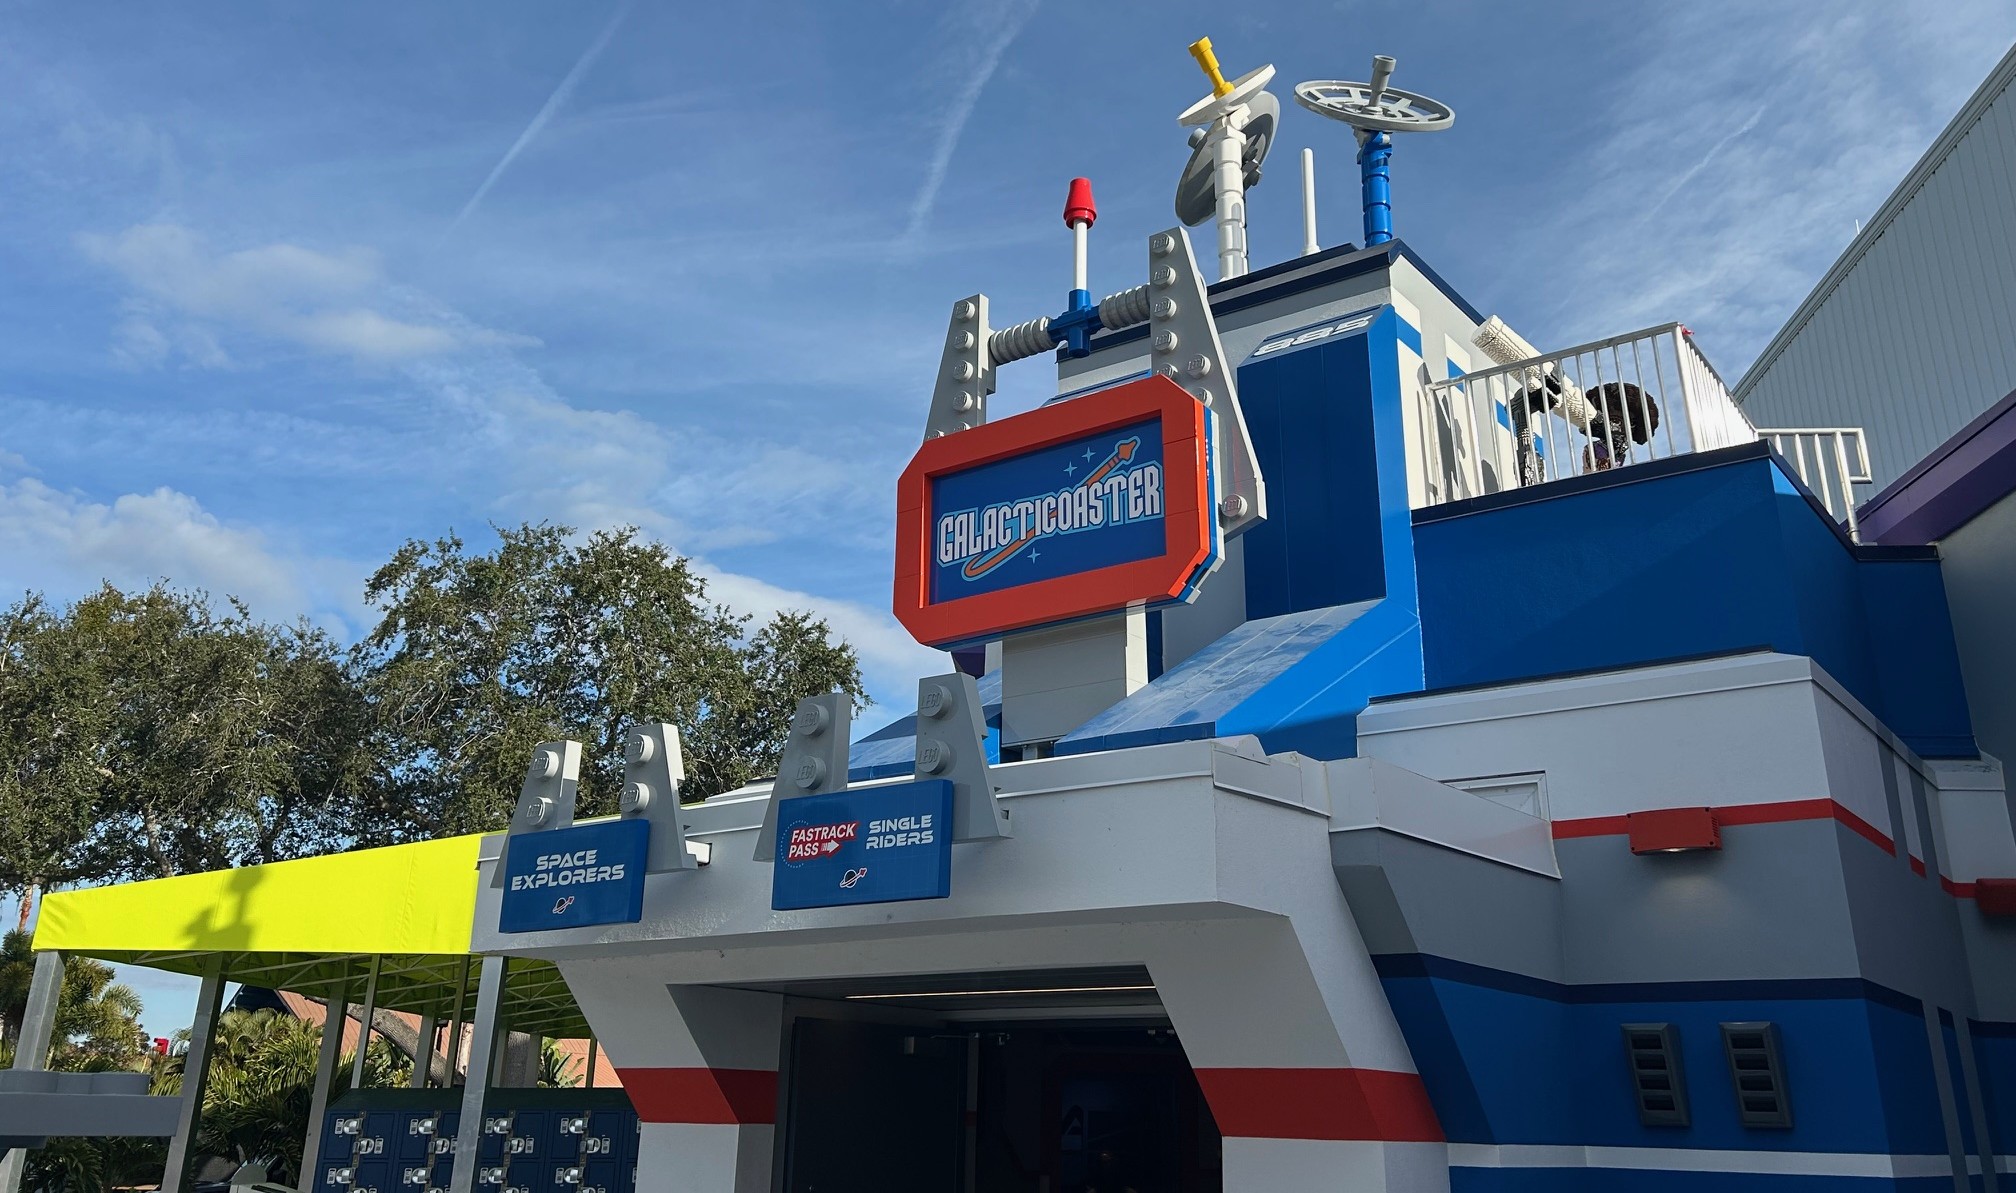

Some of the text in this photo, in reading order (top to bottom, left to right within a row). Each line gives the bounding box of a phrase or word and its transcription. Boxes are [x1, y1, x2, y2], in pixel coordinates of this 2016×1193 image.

[939, 464, 1162, 564] GALACTICOASTER
[791, 823, 857, 843] FASTRACK
[869, 814, 933, 834] SINGLE
[788, 842, 819, 858] PASS
[866, 830, 934, 850] RIDERS
[536, 849, 598, 871] SPACE
[511, 864, 625, 891] EXPLORERS
